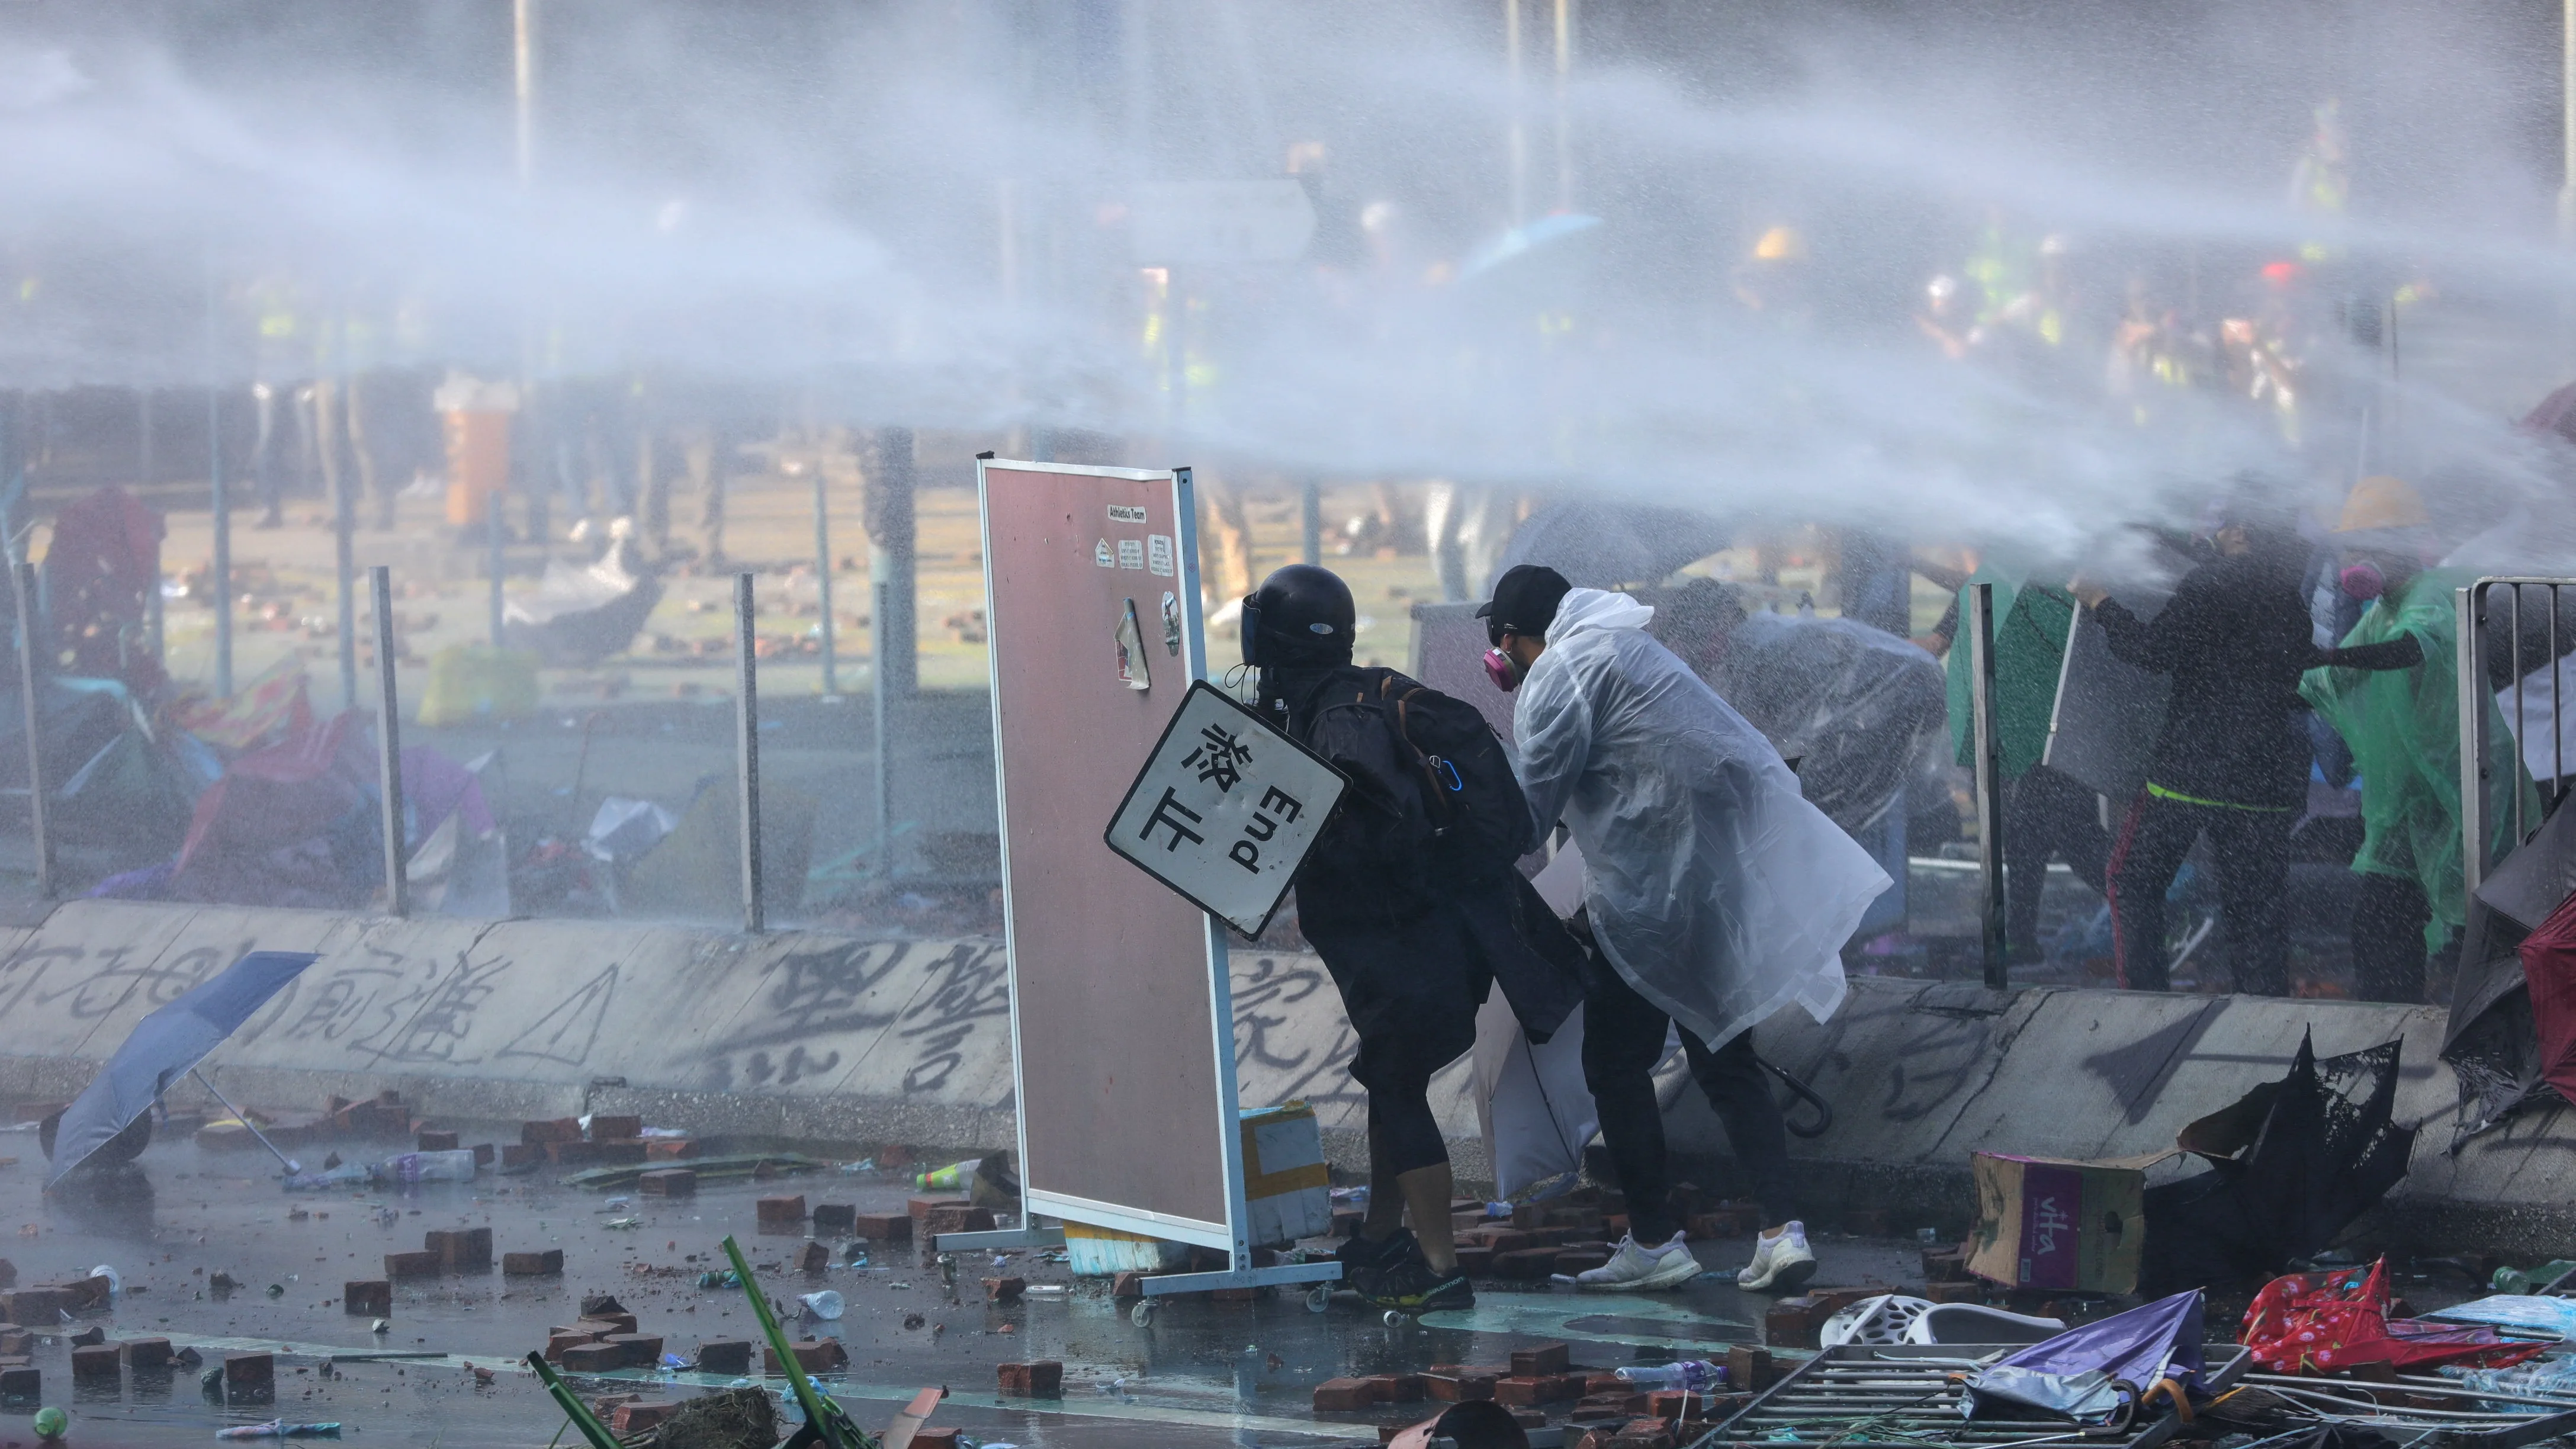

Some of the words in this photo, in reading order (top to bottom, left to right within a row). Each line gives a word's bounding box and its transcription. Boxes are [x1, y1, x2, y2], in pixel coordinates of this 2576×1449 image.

[1110, 506, 1130, 519] Athletics
[1131, 508, 1145, 520] Team
[1139, 723, 1254, 853] 終止
[1229, 785, 1302, 875] End
[2037, 1196, 2068, 1255] vita
[1427, 1277, 1463, 1296] salomon
